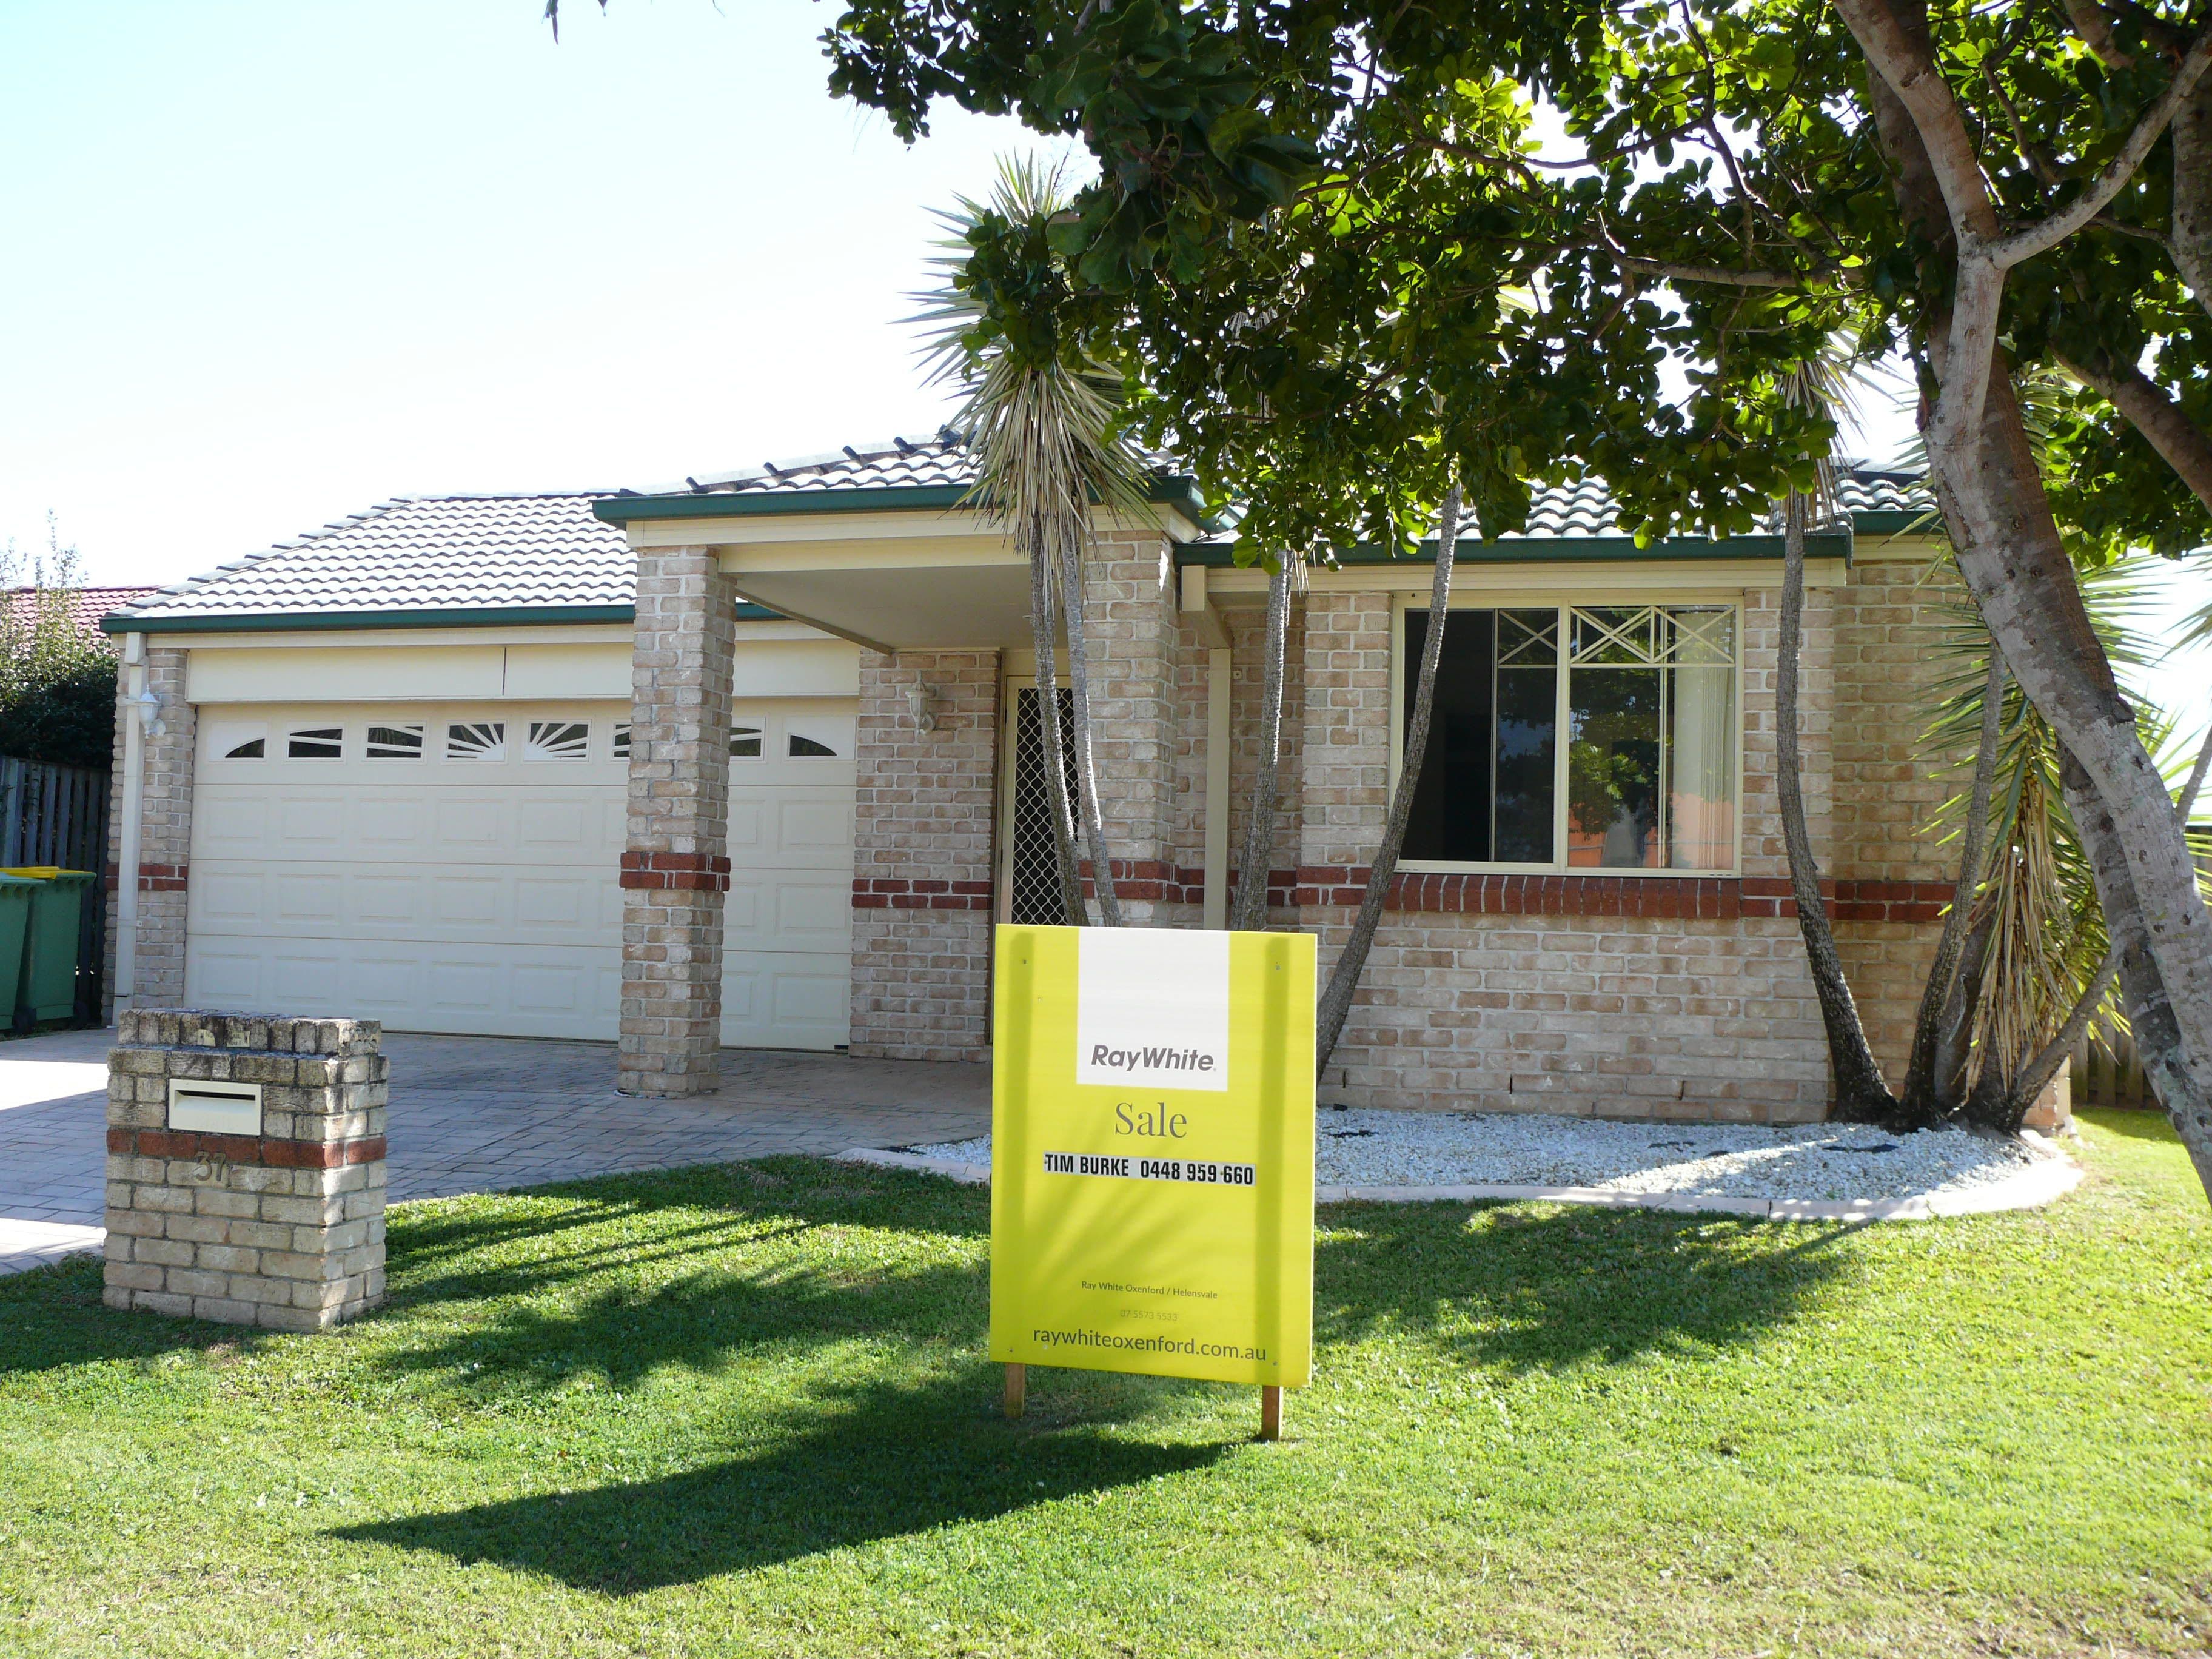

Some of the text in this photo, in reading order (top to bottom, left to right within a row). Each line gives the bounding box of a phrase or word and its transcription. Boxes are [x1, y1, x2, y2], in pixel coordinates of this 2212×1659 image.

[1115, 1102, 1187, 1138] Sale
[194, 1151, 226, 1182] 37
[1045, 1153, 1253, 1185] TIM BURKE 0448 959 660
[1081, 1281, 1096, 1292] Ray
[1098, 1282, 1124, 1292] White
[1125, 1284, 1165, 1295] Oxenford
[1172, 1288, 1218, 1299] Helensvale
[1033, 1328, 1267, 1362] raywhiteoxenford.com.au
